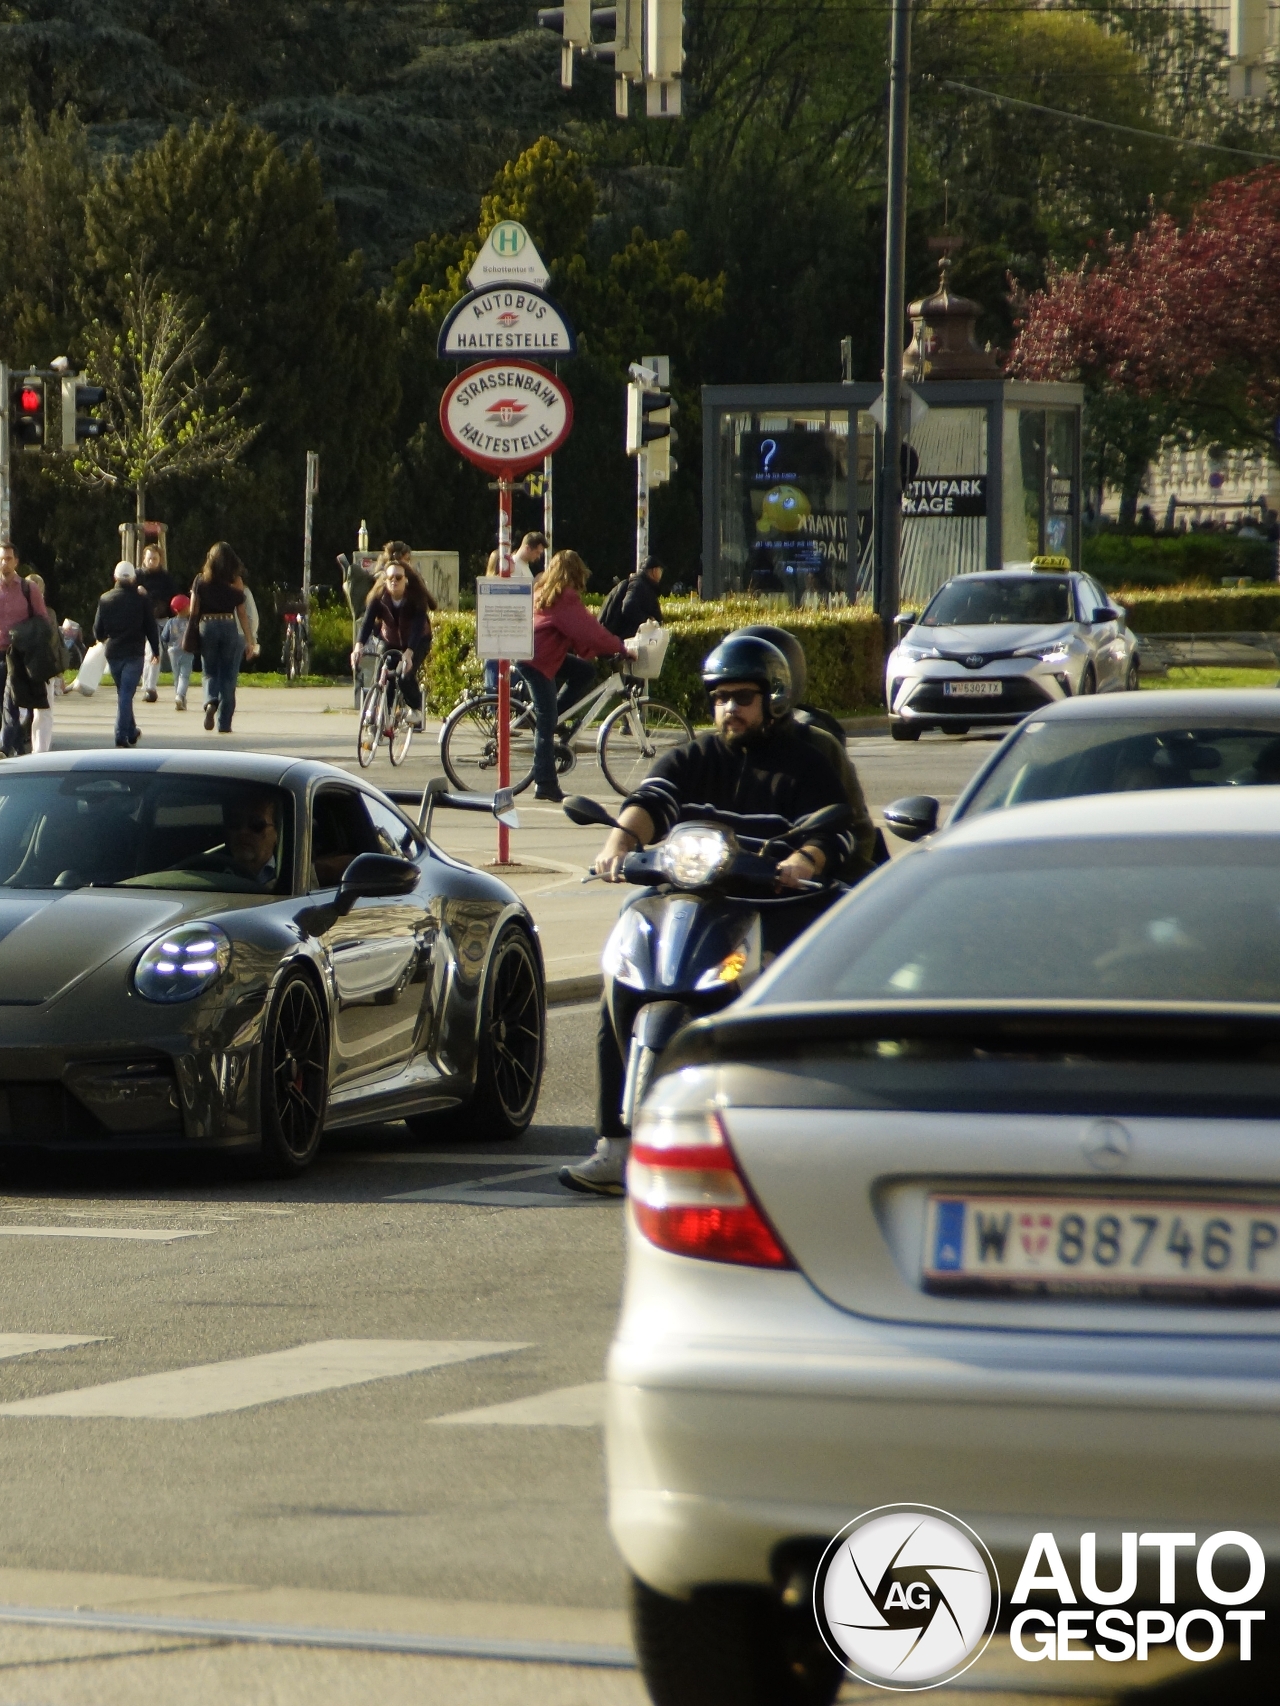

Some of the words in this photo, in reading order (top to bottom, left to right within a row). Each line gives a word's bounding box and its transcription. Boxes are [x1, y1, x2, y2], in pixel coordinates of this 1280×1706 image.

[500, 229, 517, 251] H
[483, 265, 526, 274] Schottentor
[473, 294, 547, 320] AUTOBUS
[457, 333, 559, 347] HALTESTELLE
[456, 372, 559, 408] STRASSENBAHN
[459, 423, 553, 453] HALTESTELLE
[909, 480, 982, 497] TIVPARK
